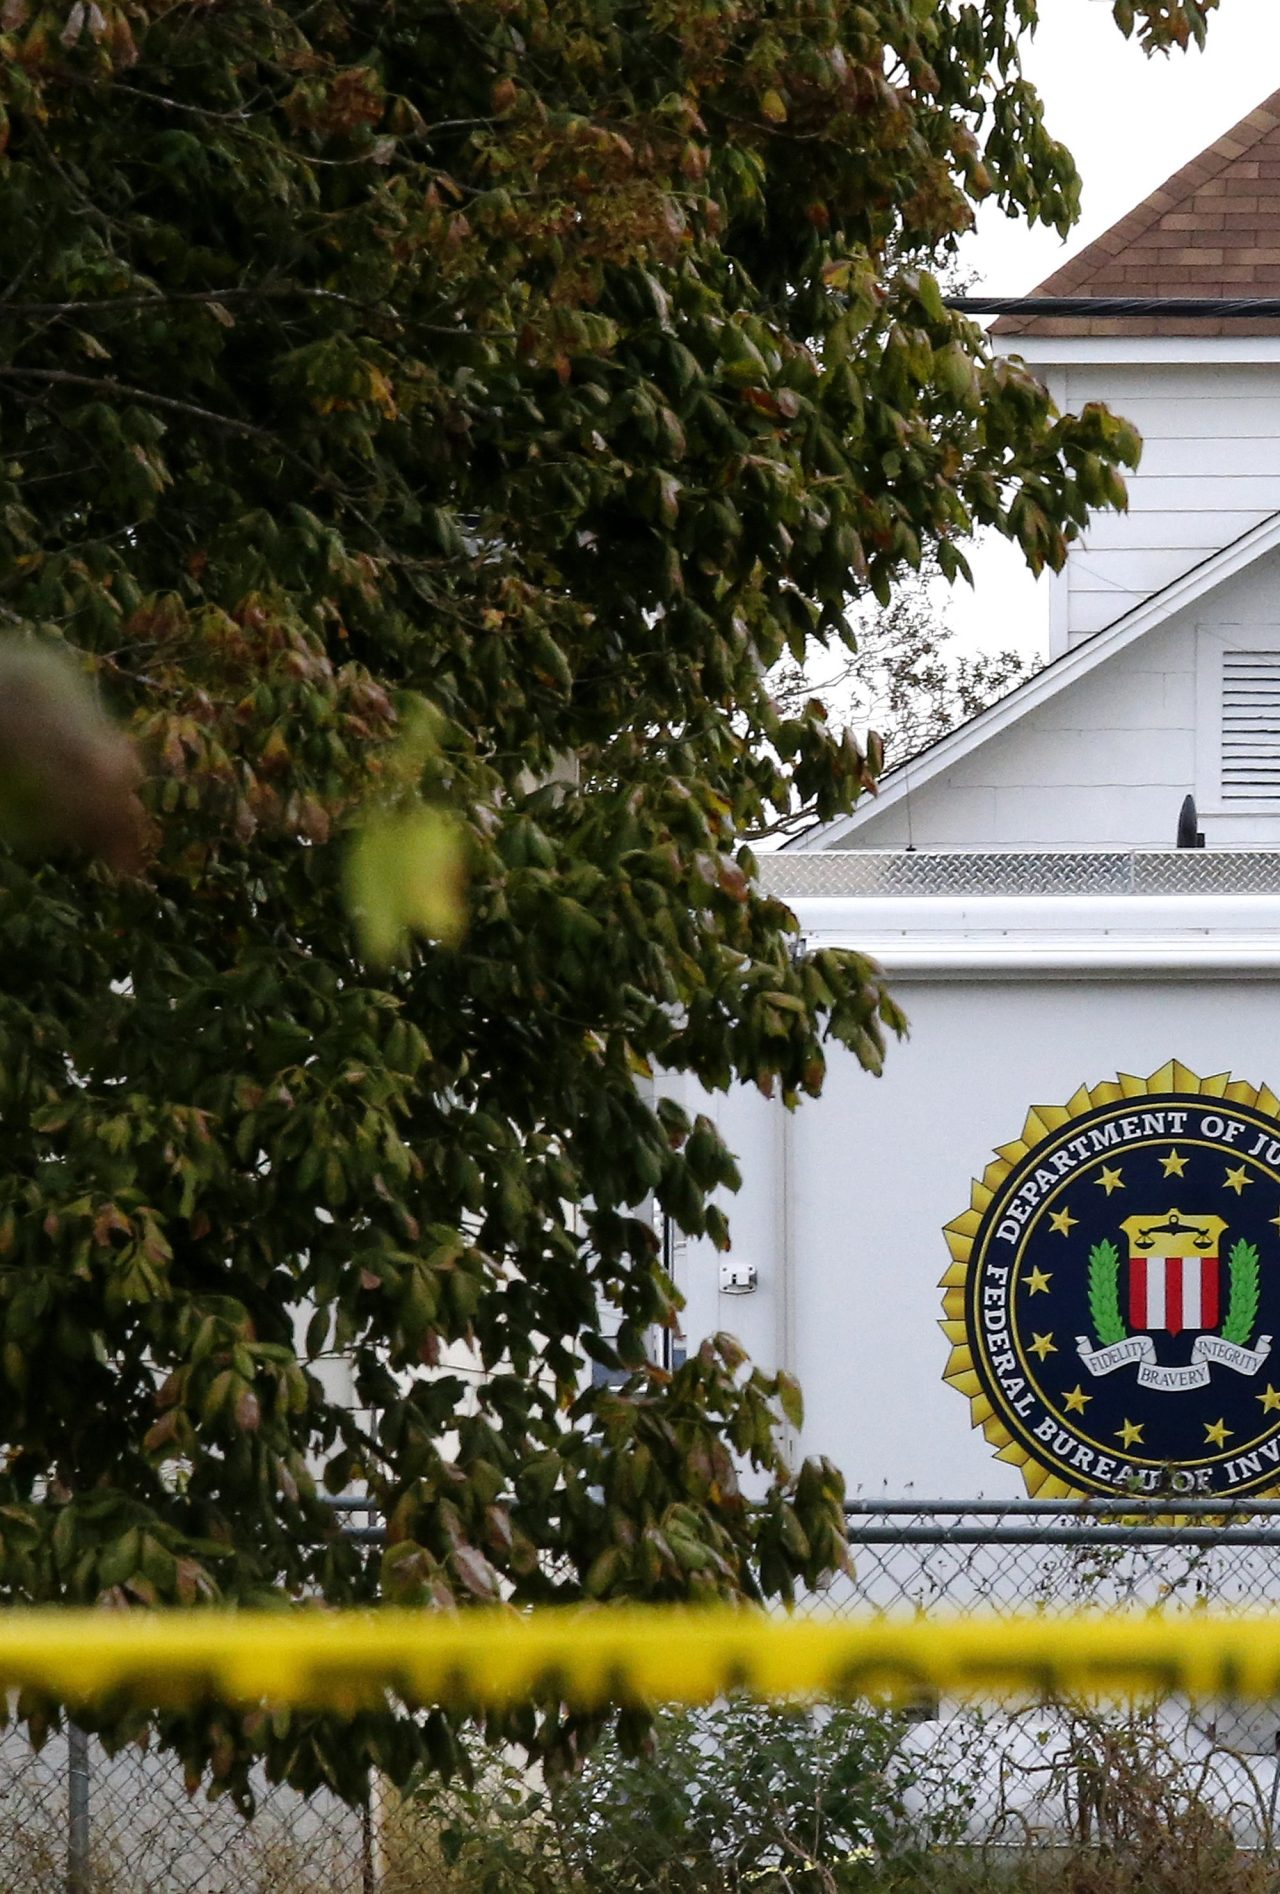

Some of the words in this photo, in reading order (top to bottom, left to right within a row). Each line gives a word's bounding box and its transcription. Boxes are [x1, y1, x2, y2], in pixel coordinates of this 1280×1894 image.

[995, 1111, 1188, 1245] DEPARTMENT
[1200, 1115, 1246, 1143] OF
[1088, 1341, 1149, 1372] FIDELITY
[1199, 1341, 1263, 1373] INTEGRITY
[983, 1263, 1036, 1418] FEDERAL
[1032, 1416, 1163, 1491] BUREAU
[1171, 1467, 1214, 1492] OF
[1140, 1367, 1206, 1387] BRAVERY
